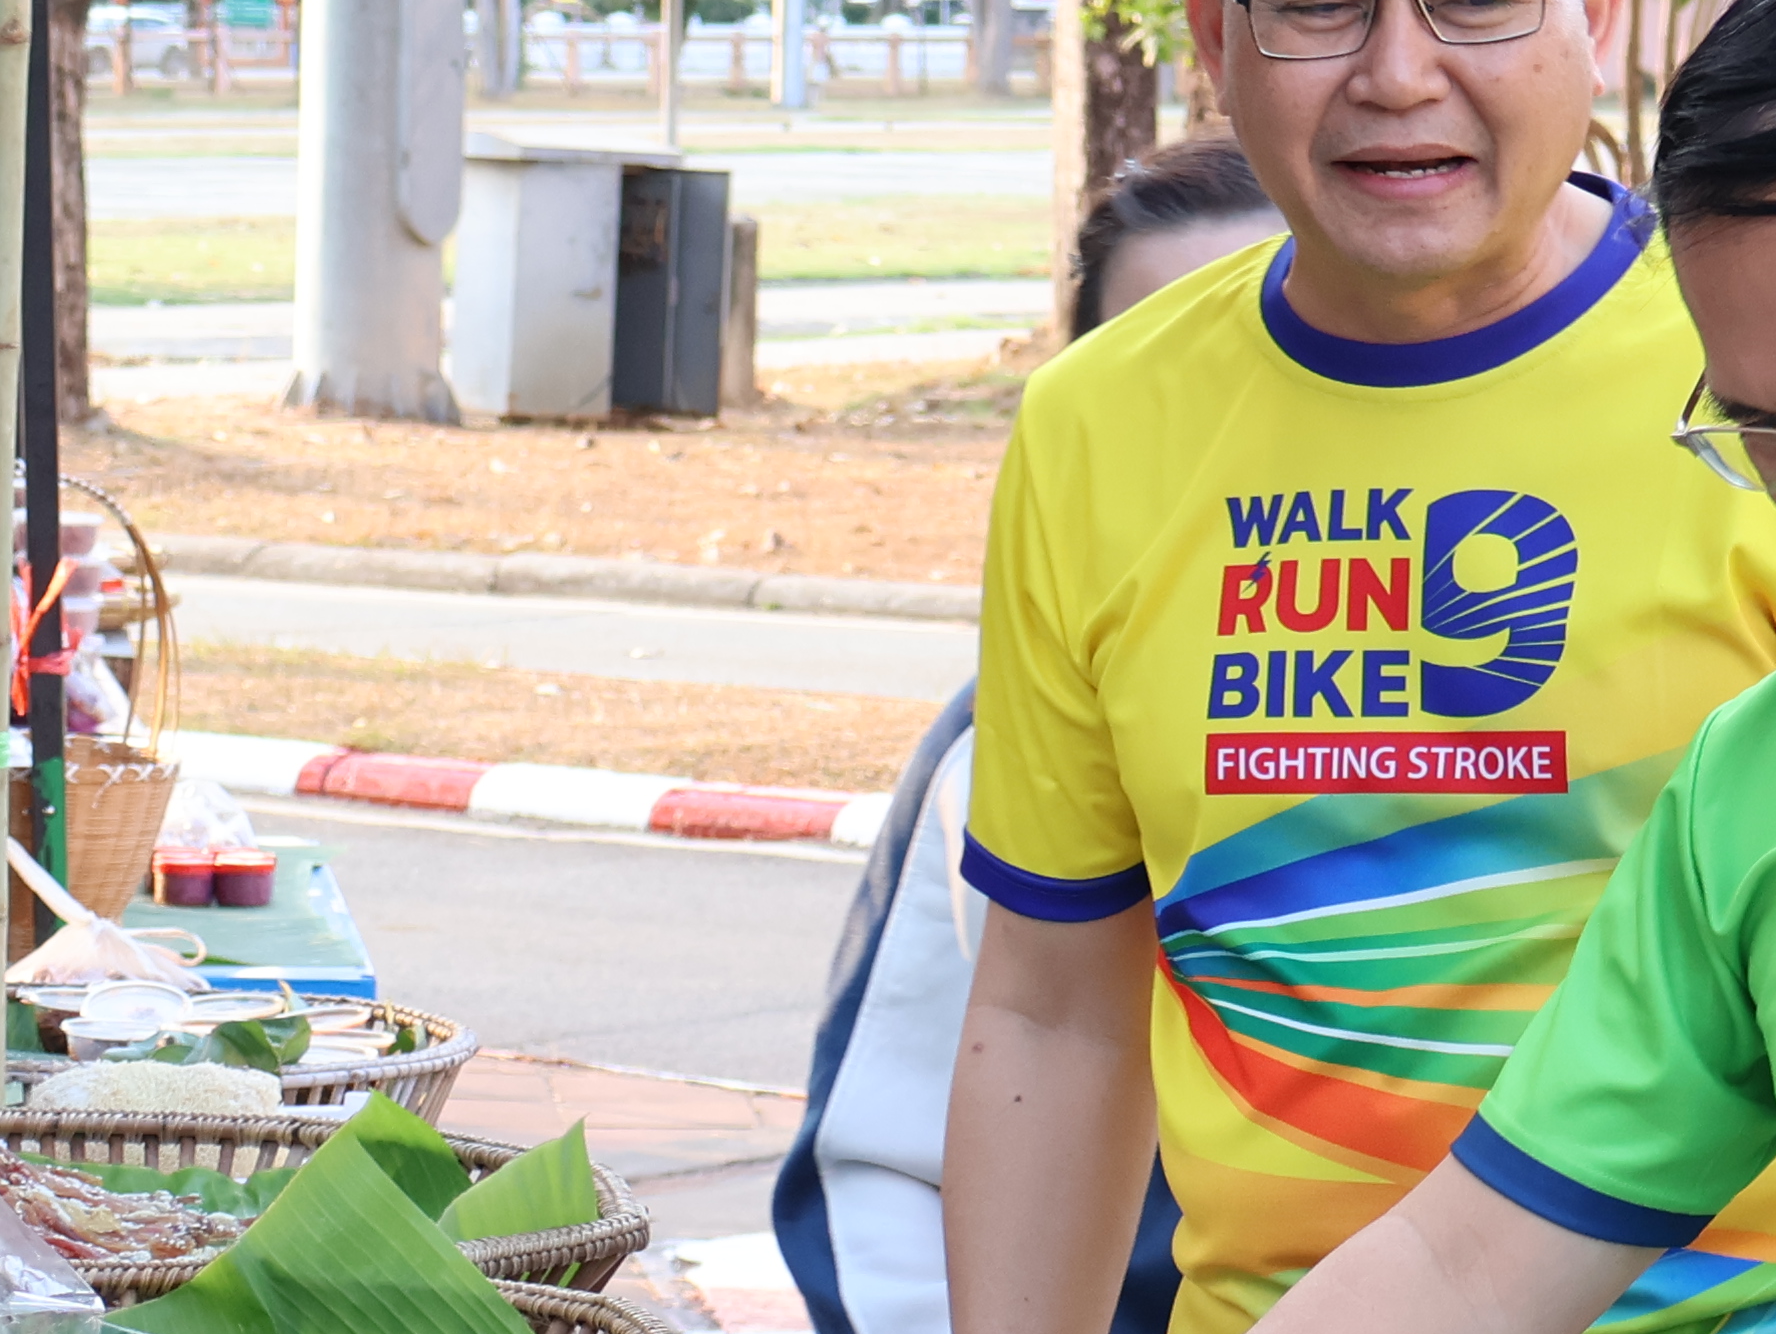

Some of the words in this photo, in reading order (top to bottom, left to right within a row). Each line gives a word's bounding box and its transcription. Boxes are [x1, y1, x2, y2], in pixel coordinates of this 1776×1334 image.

[1226, 488, 1414, 548] WALK
[1217, 556, 1411, 636] RUN
[1420, 489, 1579, 718] 9
[1207, 649, 1411, 720] BIKE
[1217, 746, 1396, 780] FIGHTING
[1407, 746, 1553, 780] STROKE
